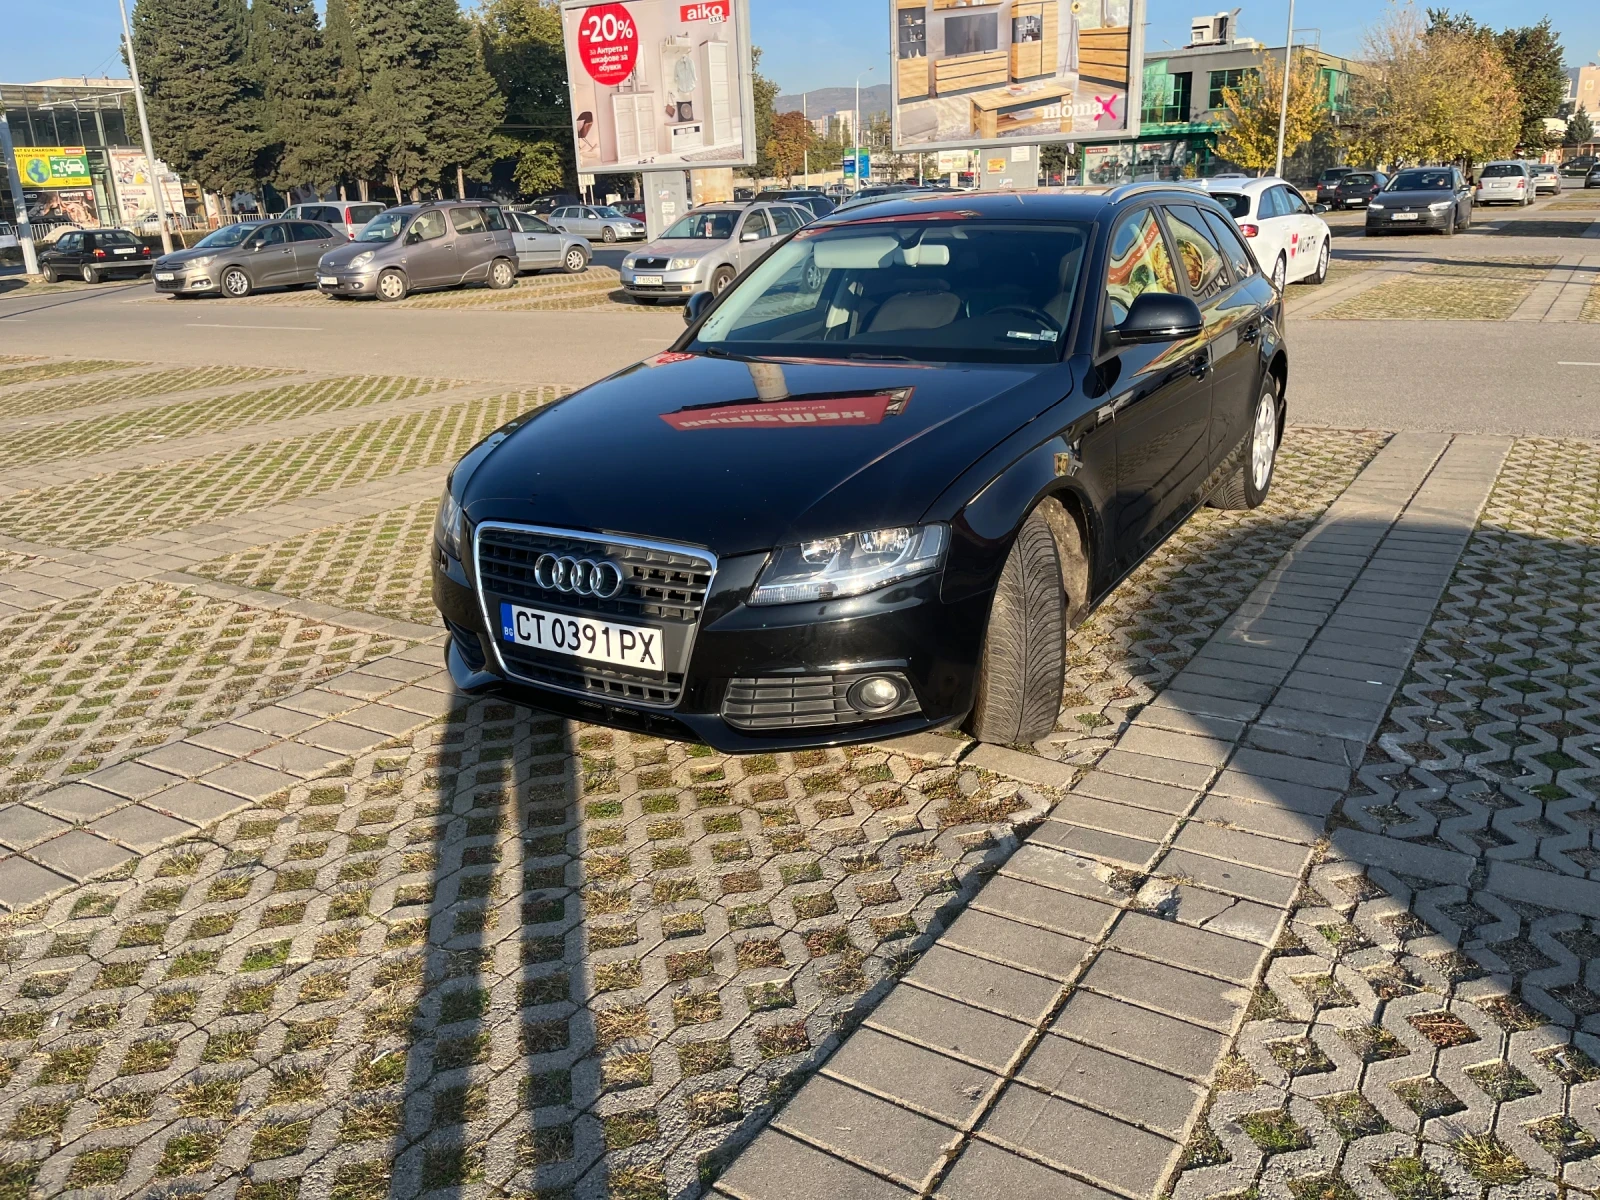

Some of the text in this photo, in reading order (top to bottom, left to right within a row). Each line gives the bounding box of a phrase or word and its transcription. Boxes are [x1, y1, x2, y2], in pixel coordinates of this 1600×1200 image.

[687, 4, 723, 20] aiko
[582, 14, 633, 42] -20%
[597, 46, 622, 55] Антрета
[591, 55, 620, 64] шкафове
[598, 62, 622, 73] обувки
[504, 627, 514, 637] BG
[516, 611, 546, 644] CT
[619, 629, 656, 665] PX
